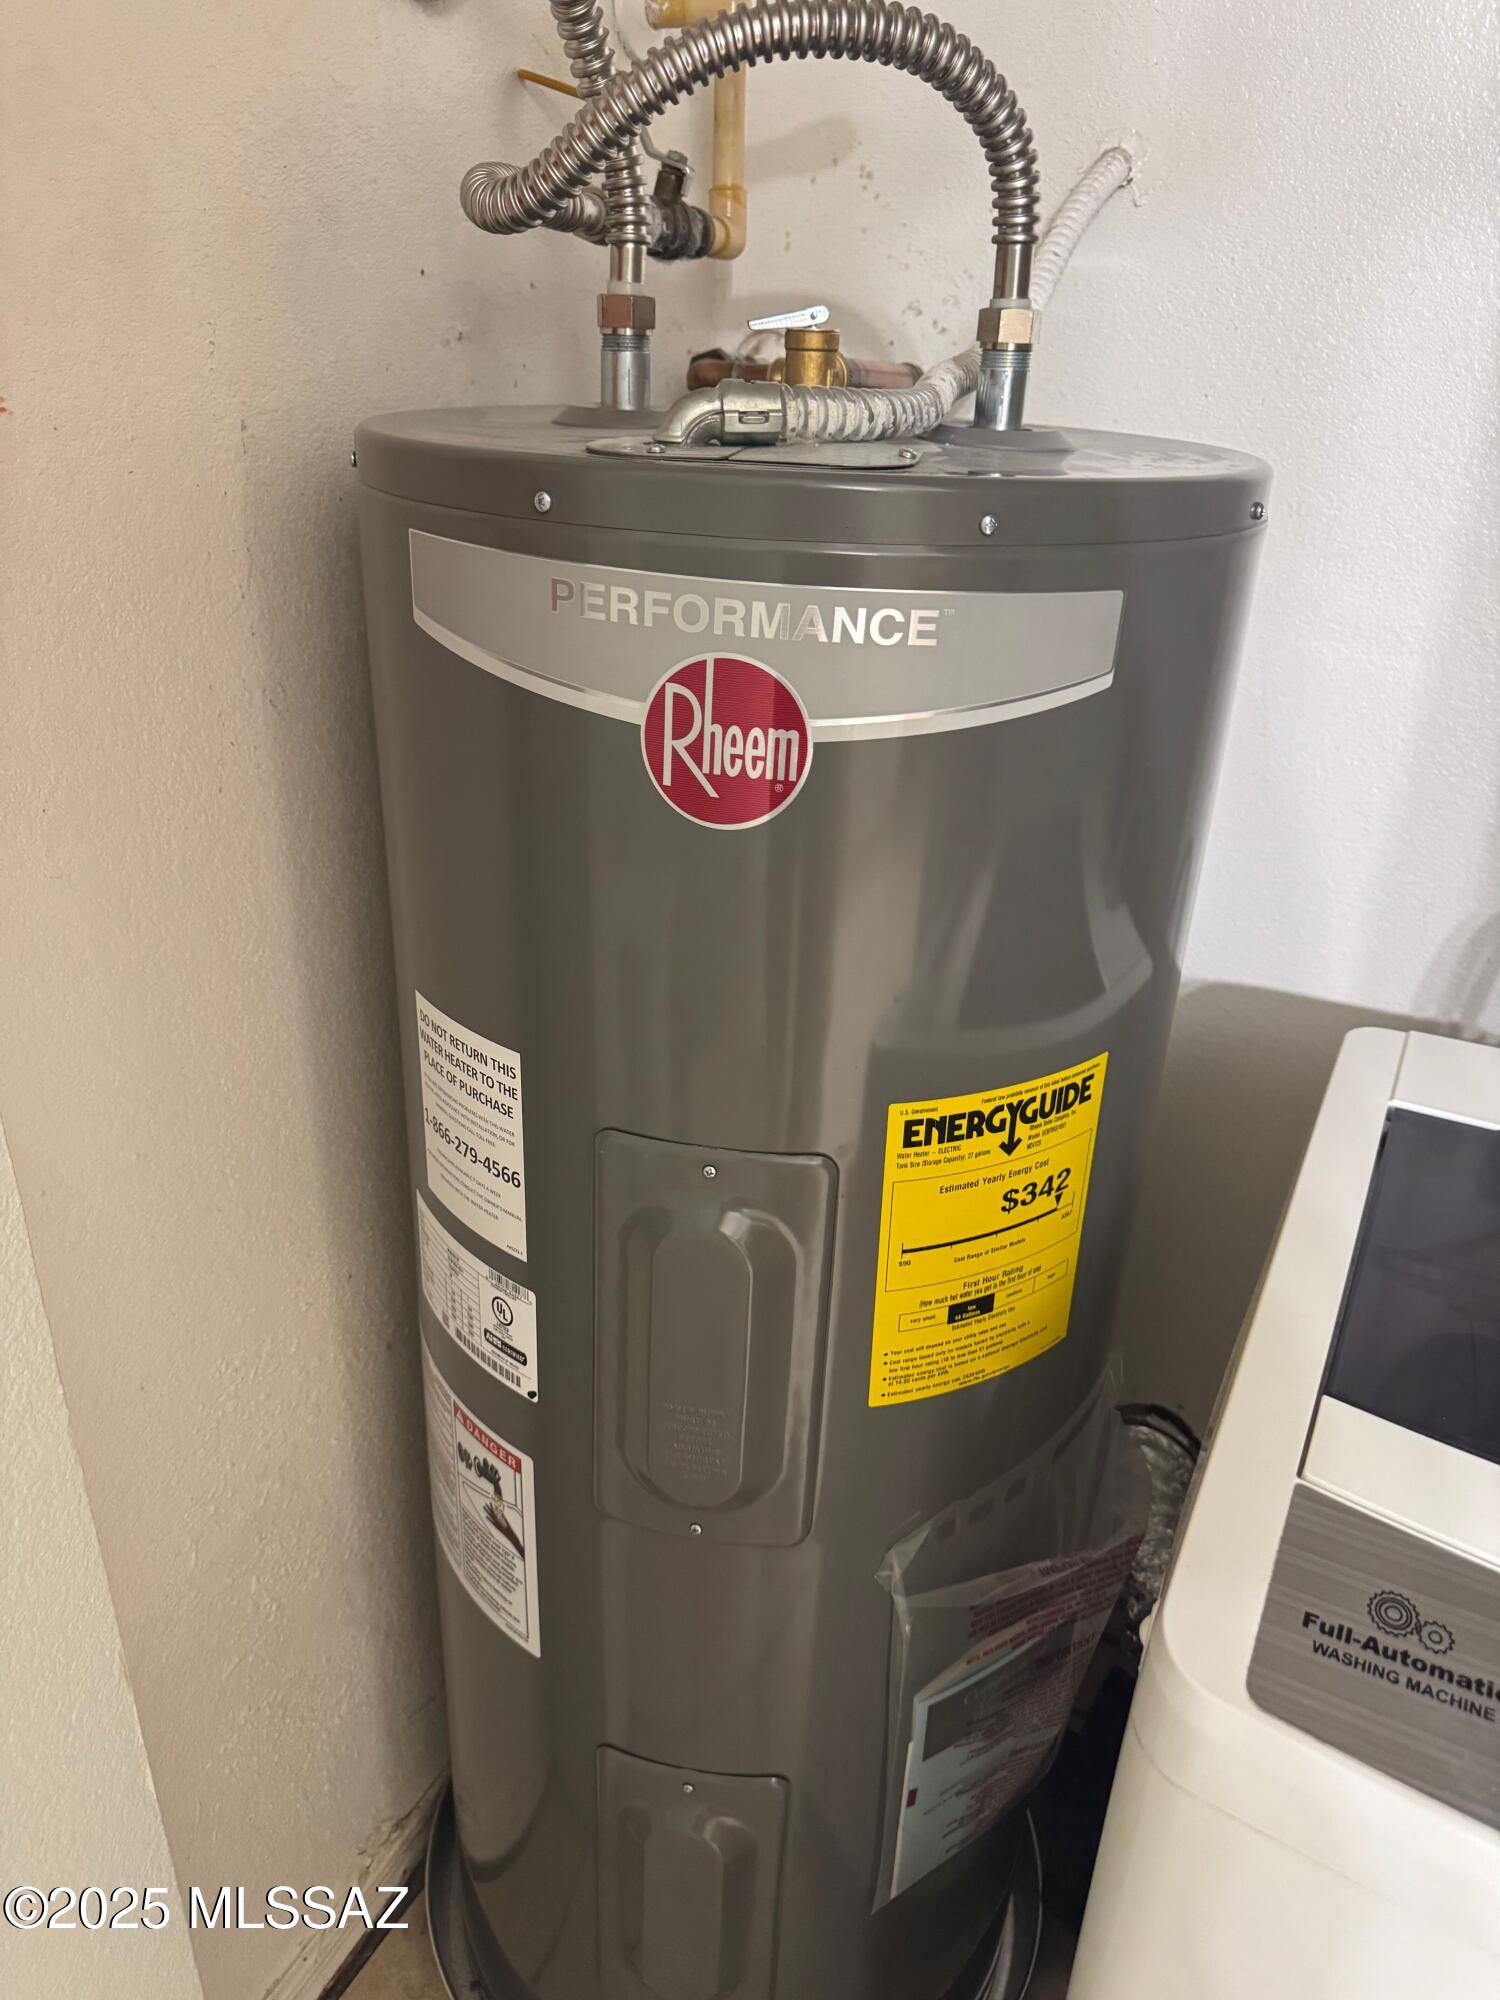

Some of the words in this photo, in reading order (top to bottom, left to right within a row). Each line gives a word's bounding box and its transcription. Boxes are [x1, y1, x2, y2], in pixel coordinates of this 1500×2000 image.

[551, 577, 940, 647] PERFORMANCE
[663, 658, 799, 798] Rheem
[420, 1008, 430, 1027] DO
[432, 1020, 447, 1041] NOT
[450, 1034, 488, 1067] RETURN
[490, 1057, 517, 1080] THIS
[420, 1026, 444, 1058] WATER
[444, 1050, 478, 1081] HEATER
[480, 1072, 494, 1089] TO
[496, 1080, 518, 1101] THE
[424, 1049, 445, 1078] PLACE
[446, 1071, 458, 1086] OF
[460, 1079, 514, 1119] PURCHASE
[903, 1073, 1095, 1151] ENERGYGUIDE
[425, 1107, 521, 1188] 1-866-279-4566
[910, 1160, 920, 1168] Size
[922, 1158, 942, 1168] (Storage
[975, 1149, 991, 1158] gallons
[914, 1150, 929, 1158] Heater
[938, 1145, 961, 1154] ELECTRIC
[939, 1180, 979, 1194] Estimated
[983, 1172, 1006, 1185] Yearly
[1008, 1165, 1032, 1178] Energy
[1034, 1158, 1049, 1170] Cost
[1001, 1167, 1071, 1214] $342
[963, 1279, 980, 1290] First
[982, 1273, 1000, 1284] Hour
[1002, 1265, 1024, 1278] Rating
[967, 1251, 983, 1260] Range
[497, 1301, 509, 1322] UL
[919, 1299, 933, 1309] (How
[934, 1296, 948, 1304] much
[466, 1421, 517, 1469] DANGER
[1313, 1639, 1400, 1684] WASHING
[1405, 1677, 1496, 1722] MACHINE
